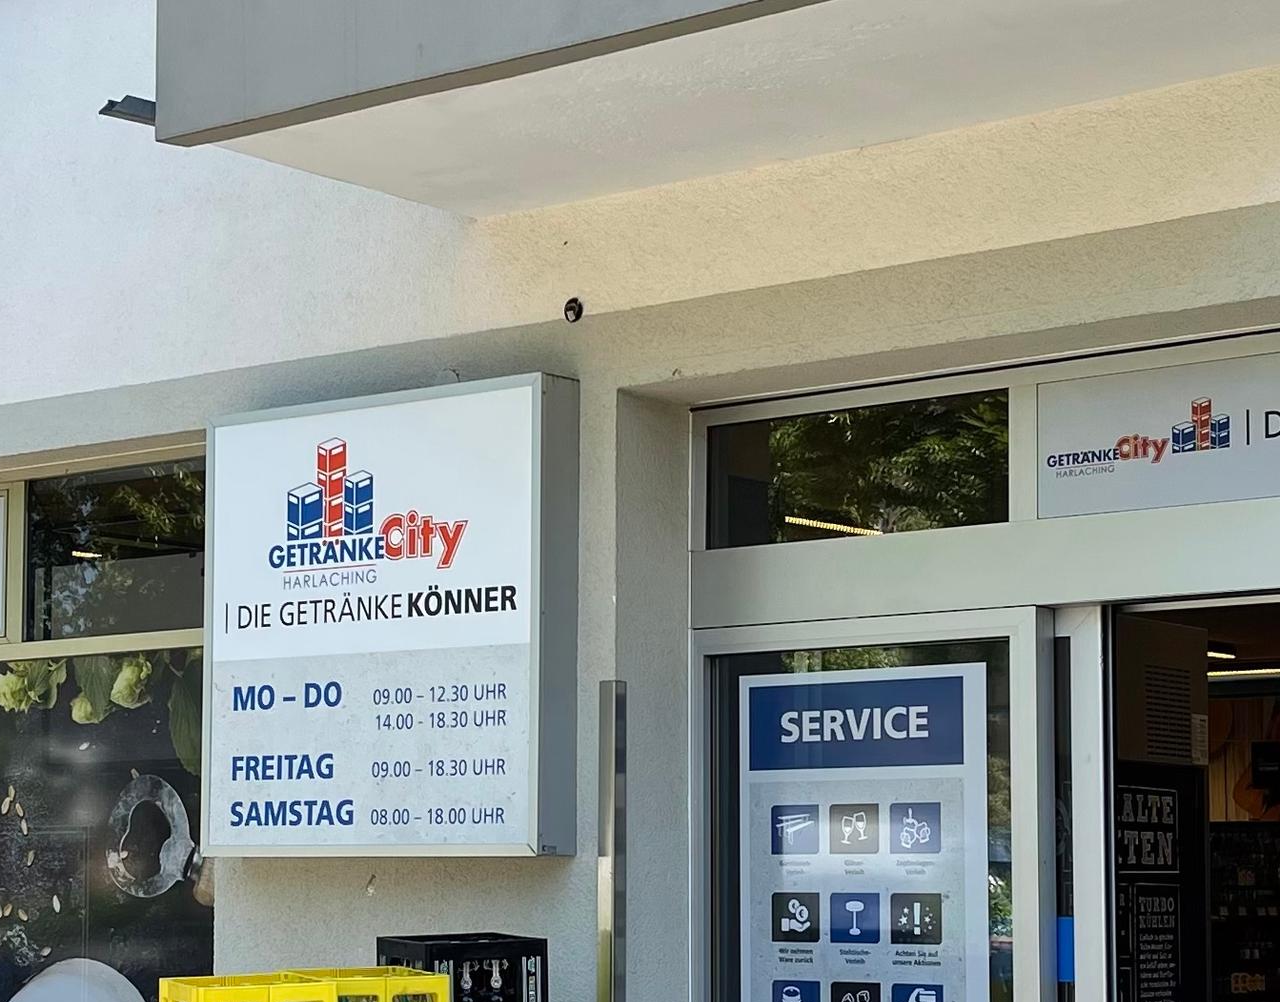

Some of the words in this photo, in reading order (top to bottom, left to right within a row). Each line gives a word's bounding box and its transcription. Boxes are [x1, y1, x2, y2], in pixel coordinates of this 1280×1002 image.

[1046, 446, 1120, 470] GETRÄNKE
[1115, 433, 1171, 464] City
[1055, 463, 1115, 479] HARLACHING
[268, 535, 385, 570] GETRÄNKE
[379, 508, 470, 570] City
[282, 567, 378, 591] HARLACHING
[237, 601, 272, 631] DIE
[278, 588, 404, 629] GETRÄNKE
[407, 584, 518, 618] KÖNNER
[232, 684, 276, 711] MO
[303, 681, 343, 709] DO
[372, 687, 413, 706] 09.00
[429, 684, 469, 702] 12.30
[473, 683, 508, 700] UHR
[375, 713, 414, 731] 14.00
[429, 711, 468, 729] 18.30
[473, 709, 507, 727] UHR
[780, 704, 930, 744] SERVICE
[231, 752, 335, 781] FREITAG
[371, 760, 412, 778] 09.00
[428, 759, 468, 777] 18.30
[472, 758, 507, 776] UHR
[229, 799, 355, 827] SAMSTAG
[370, 808, 410, 826] 08.00
[427, 807, 467, 825] 18.00
[471, 807, 506, 825] UHR
[1118, 793, 1174, 824] ALTE
[1138, 896, 1175, 912] TURBO
